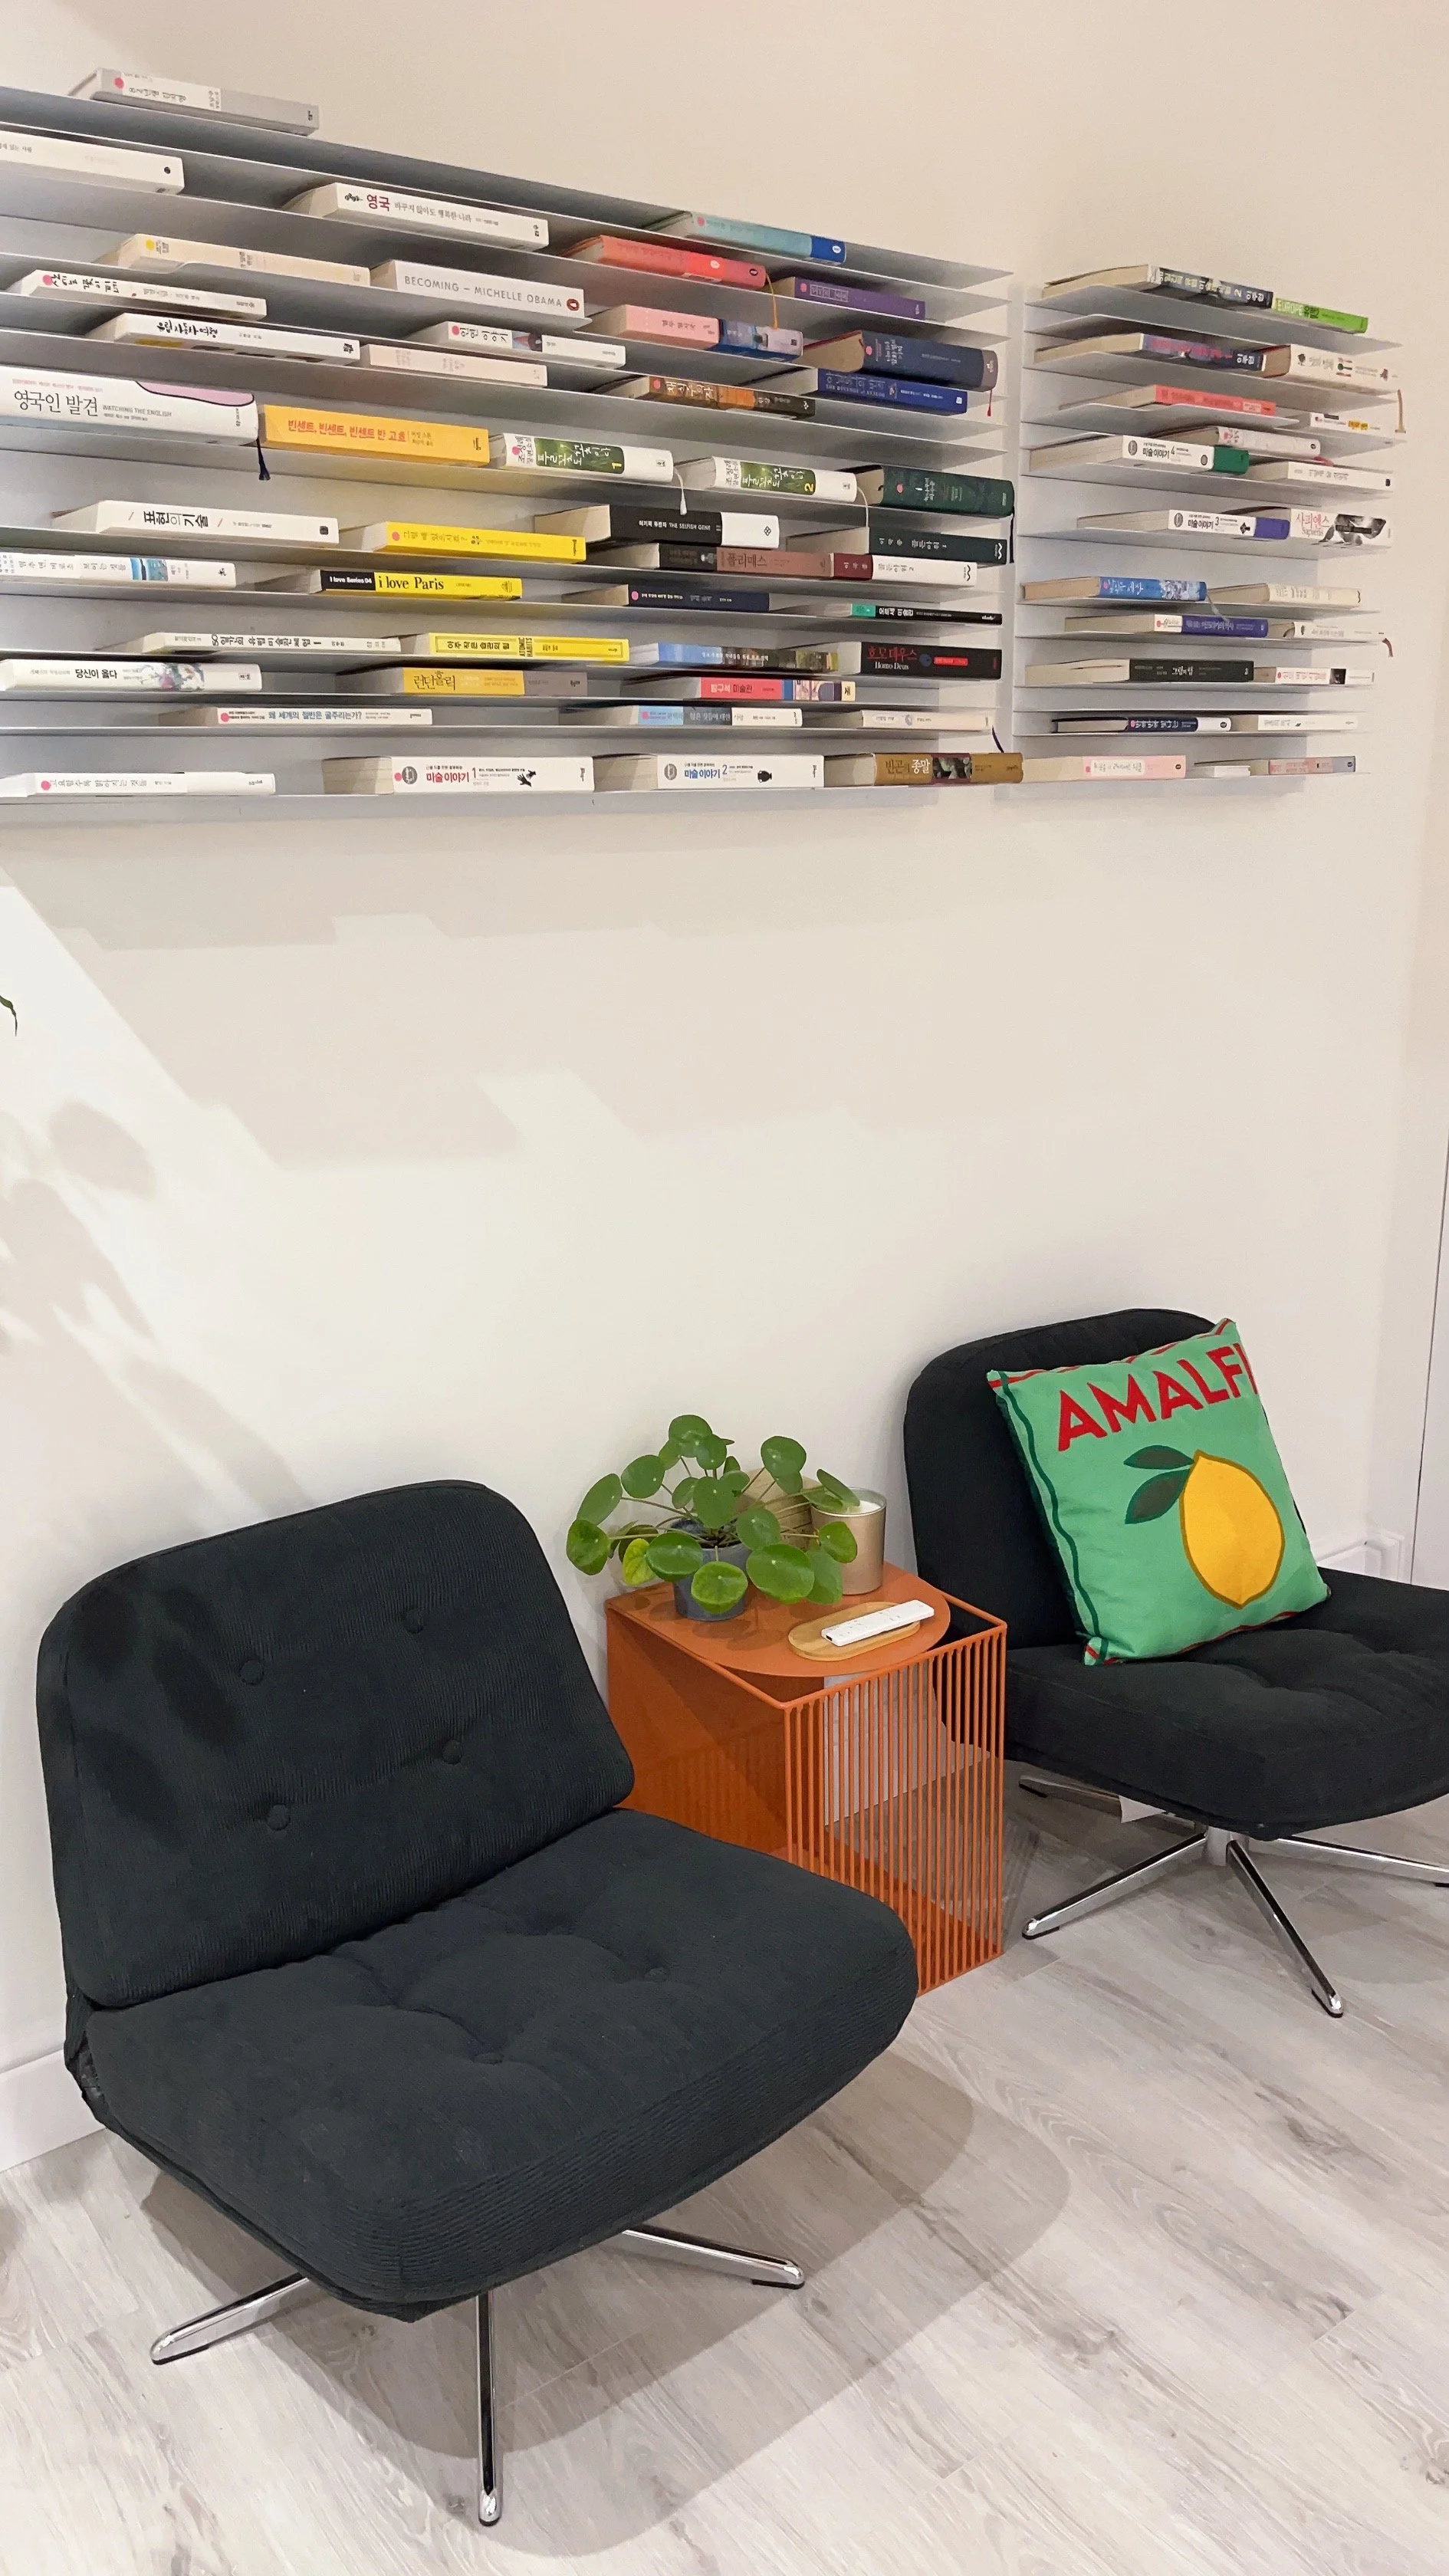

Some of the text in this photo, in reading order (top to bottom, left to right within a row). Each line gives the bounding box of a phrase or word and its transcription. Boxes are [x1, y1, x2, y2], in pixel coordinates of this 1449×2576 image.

[405, 275, 563, 307] BECOMING MICHELLE OBAMA
[481, 330, 508, 343] 이야기
[14, 389, 99, 417] 영국인 발견
[288, 419, 407, 442] 빈센트, 빈센트, 빈센트 반 고흐
[611, 462, 623, 470] 1
[804, 482, 814, 492] 2
[726, 551, 767, 569] 폴리매스
[378, 575, 445, 591] i love Paris
[874, 661, 910, 672] Homo Deus
[75, 668, 100, 679] 당신이
[101, 669, 118, 680] 옳다
[710, 683, 753, 694] 방구석 미술관
[268, 711, 276, 720] 왜
[721, 764, 728, 775] 2
[912, 758, 931, 774] 종말
[1057, 1342, 1258, 1452] AMALFI
